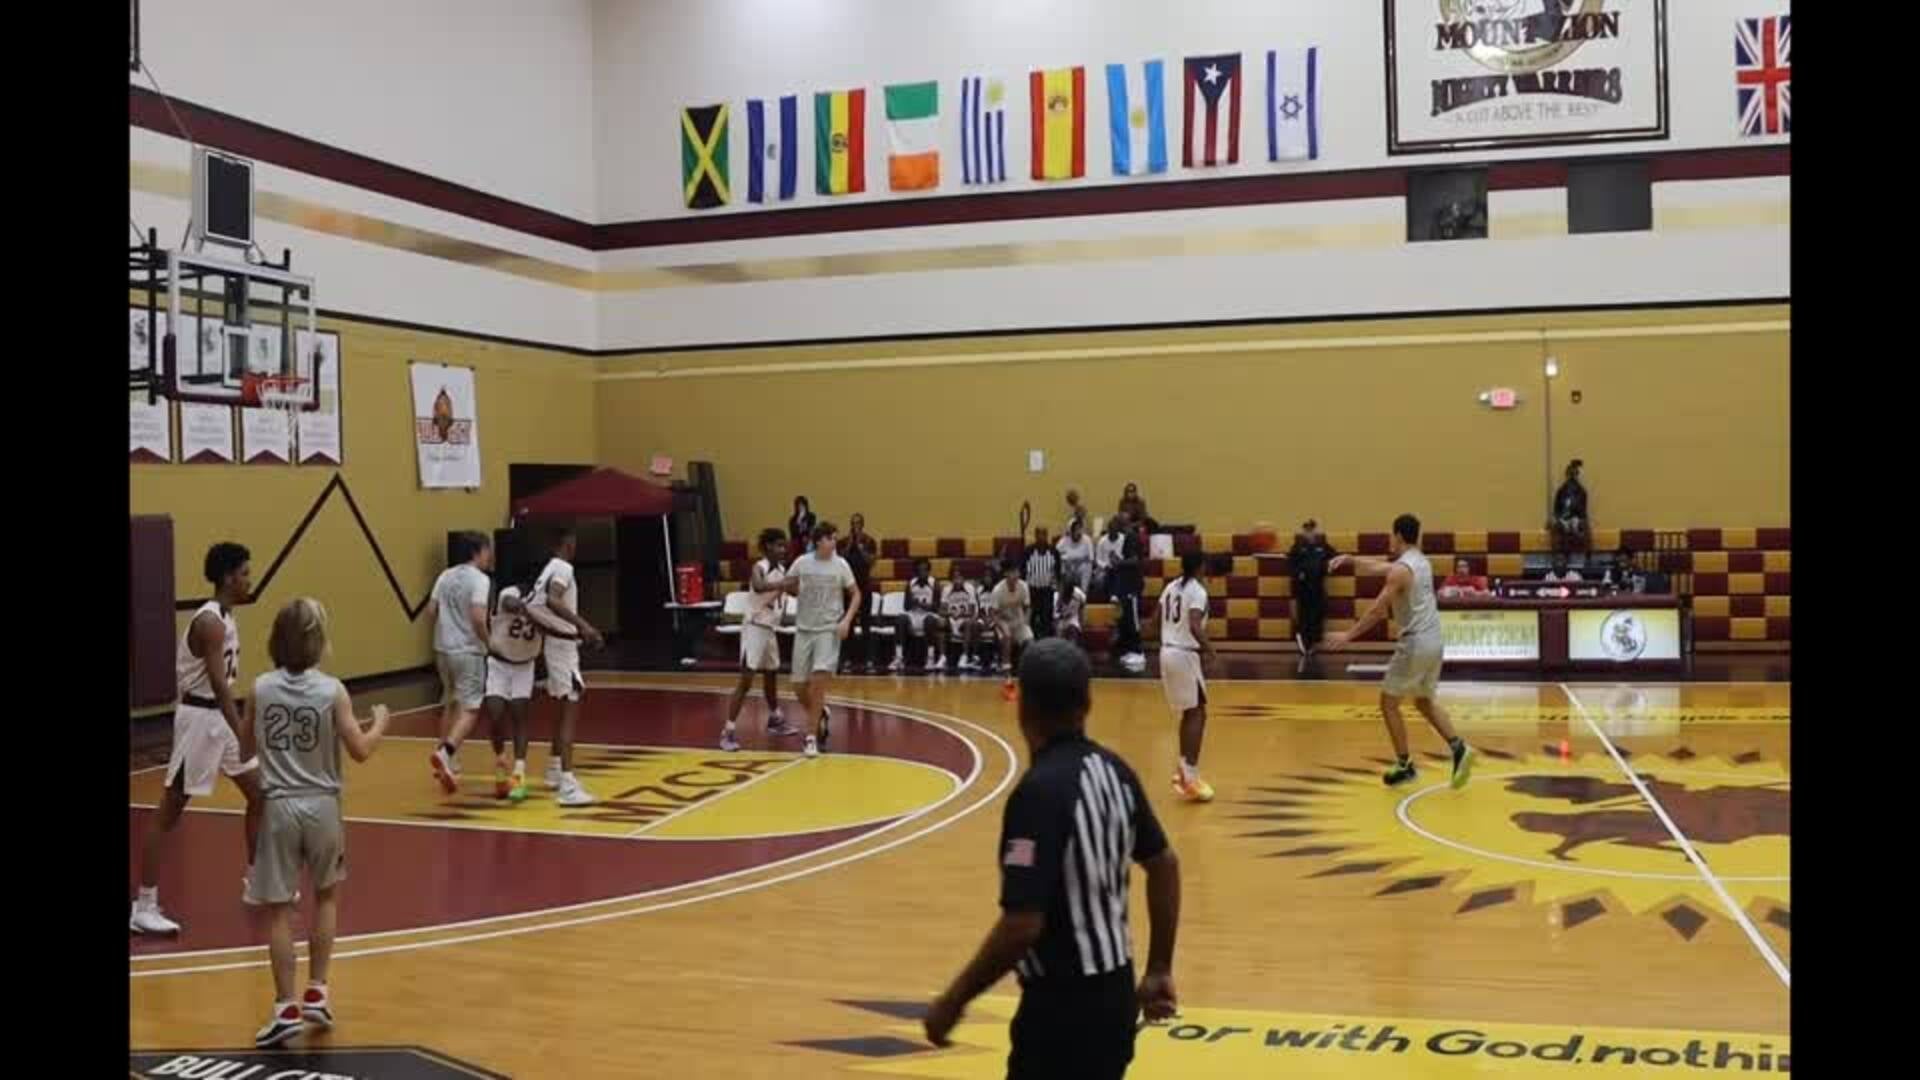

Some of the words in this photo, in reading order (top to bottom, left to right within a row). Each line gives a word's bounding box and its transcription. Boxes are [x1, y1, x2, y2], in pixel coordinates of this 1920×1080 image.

[1435, 15, 1535, 50] MOUNT
[1561, 11, 1621, 42] ZION
[1430, 74, 1508, 116] MIGHTY
[1513, 67, 1622, 104] WARRIORS
[1535, 101, 1562, 120] THE
[1165, 593, 1182, 624] 13
[264, 704, 320, 752] 23
[1264, 1024, 1411, 1053] with
[149, 1055, 266, 1080] BULL
